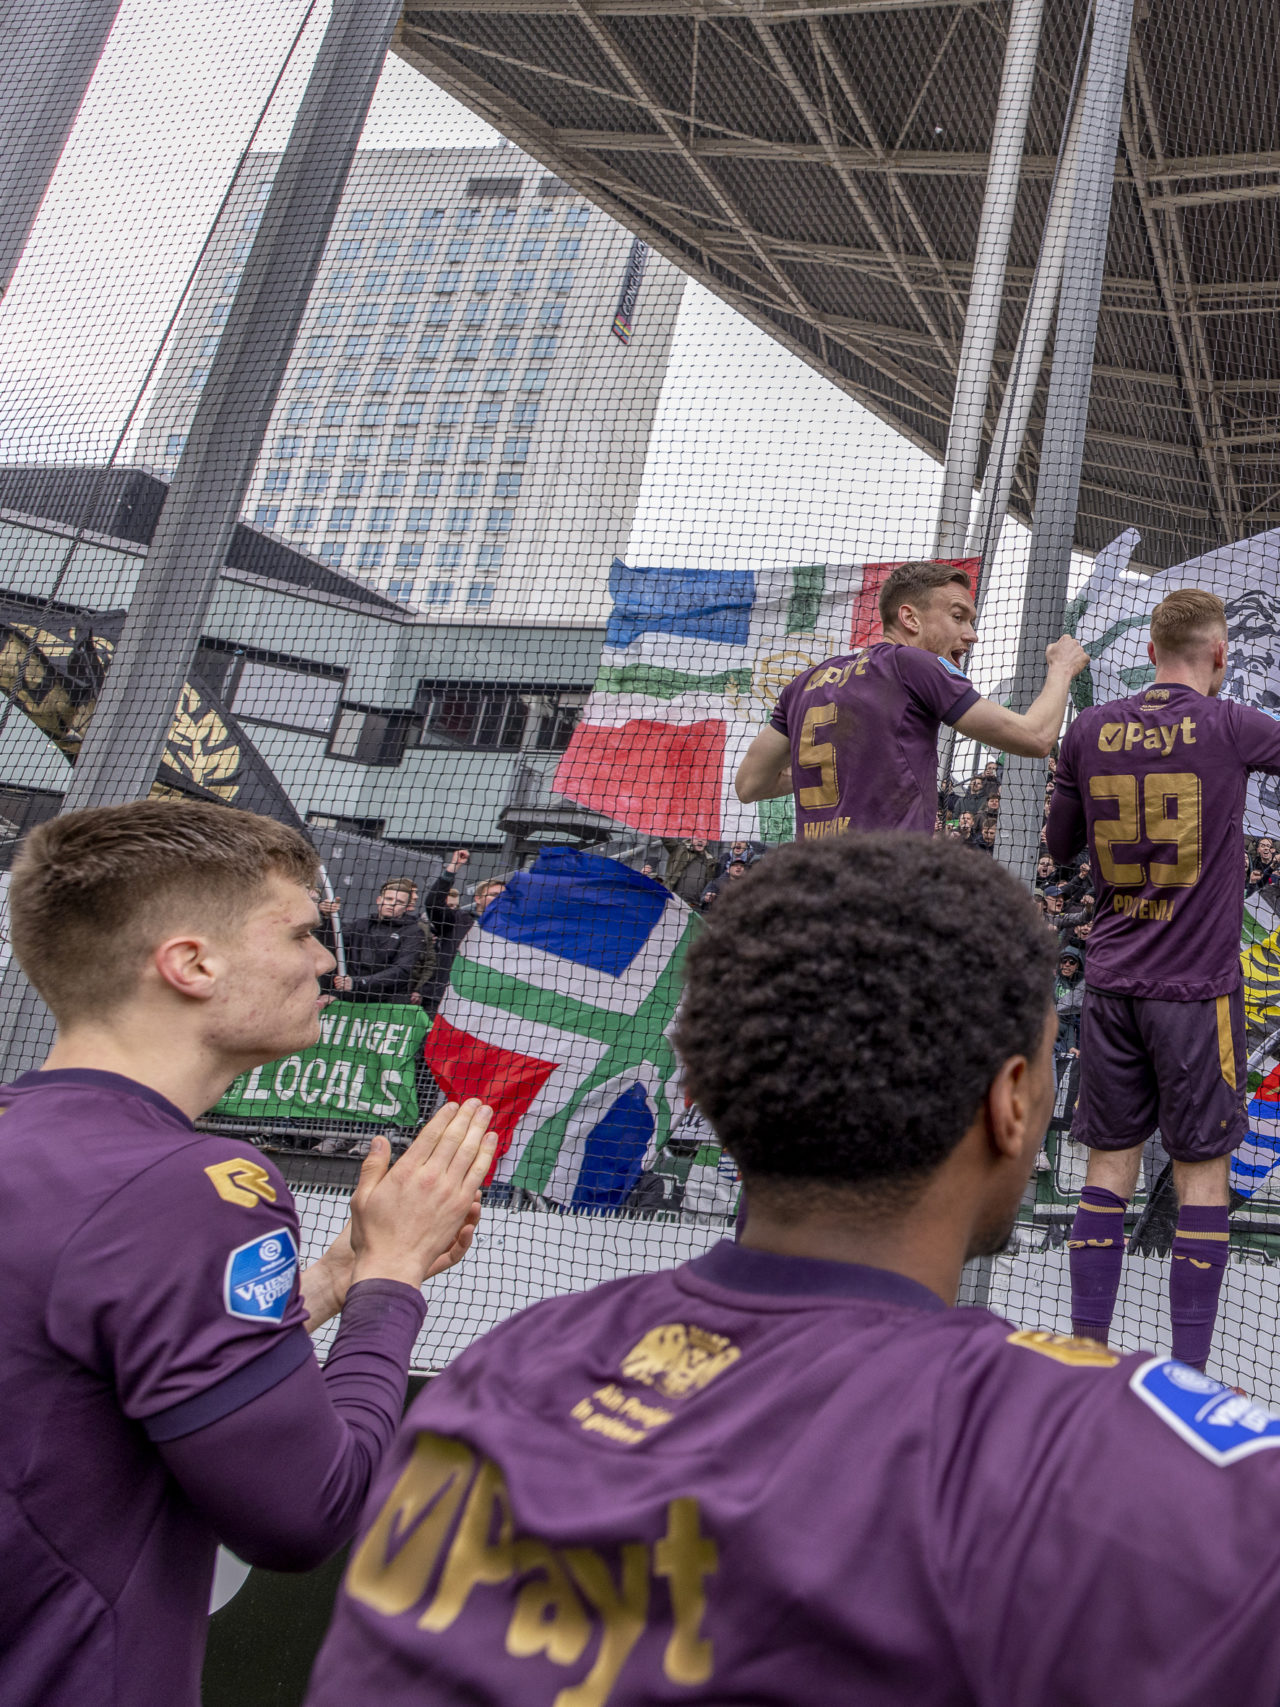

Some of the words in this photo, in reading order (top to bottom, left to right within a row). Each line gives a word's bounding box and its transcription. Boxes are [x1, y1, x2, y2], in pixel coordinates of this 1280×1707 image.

[799, 702, 839, 810] 5
[1124, 716, 1197, 757] Payt
[1089, 773, 1202, 888] 29
[242, 1055, 402, 1117] LOCALS
[416, 1458, 719, 1707] Payt
